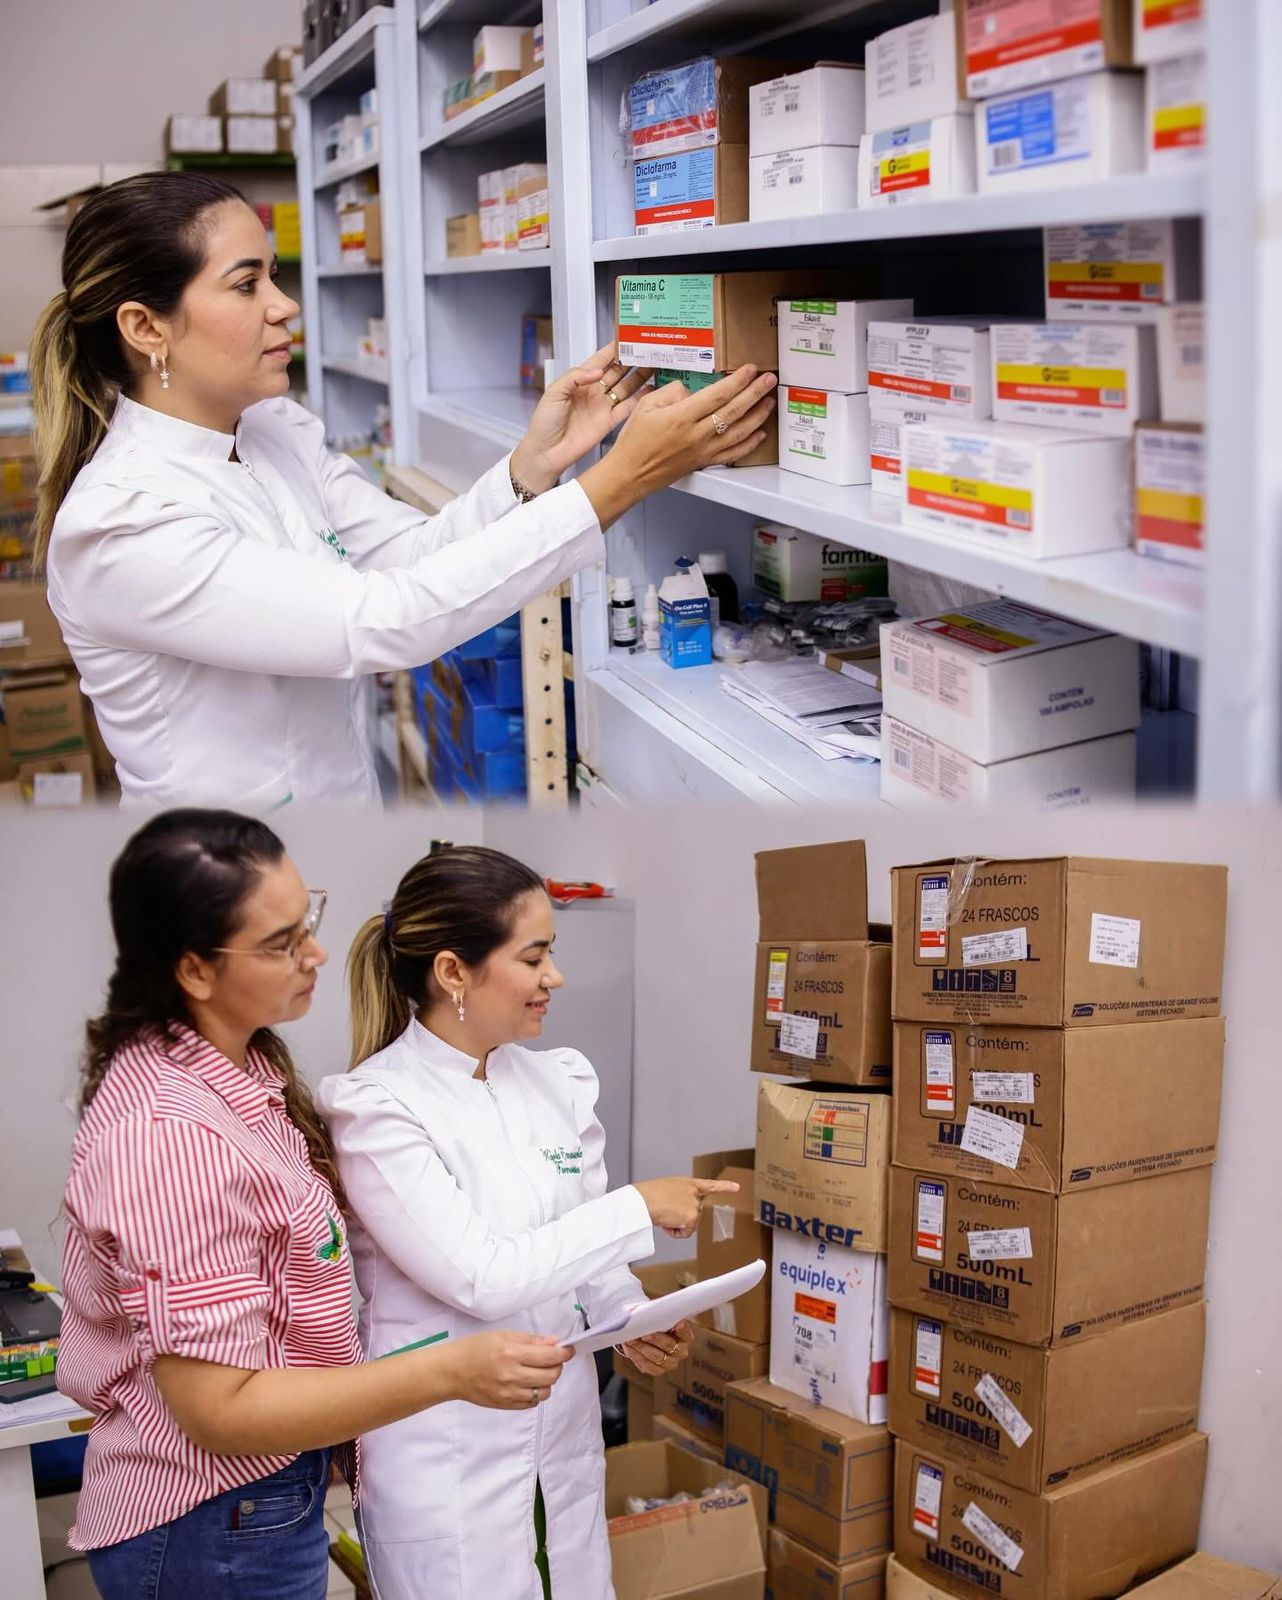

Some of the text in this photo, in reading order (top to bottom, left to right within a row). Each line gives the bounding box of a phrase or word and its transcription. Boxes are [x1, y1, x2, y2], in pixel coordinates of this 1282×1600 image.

[636, 161, 677, 177] Diclofarma
[622, 280, 665, 291] Vitamina C
[821, 544, 888, 564] farma
[962, 906, 1040, 923] 24 FRASCOS
[796, 951, 838, 963] Contém:
[793, 979, 845, 994] 24 FRASCOS
[1098, 1002, 1130, 1011] SOLUÇÕES
[1131, 1000, 1168, 1010] PARENTERAIS
[1176, 998, 1199, 1006] GRANDE
[1136, 1009, 1159, 1017] SISTEMA
[794, 1010, 843, 1028] 0mL
[965, 1034, 1030, 1052] Contém:
[970, 1102, 1043, 1128] 00mL
[1096, 1145, 1216, 1174] SOLUÇÕES PARENTERAIS DE GRANDE VOLUME
[1133, 1159, 1183, 1174] SISTEMA FECHADO
[957, 1187, 1021, 1212] Contém:
[760, 1199, 863, 1249] Baxter
[957, 1219, 971, 1234] 24
[780, 1261, 847, 1295] equiplex
[956, 1252, 1034, 1287] 500mL
[796, 1325, 813, 1341] 708
[953, 1330, 1013, 1359] Contém:
[952, 1361, 967, 1376] 24
[691, 1381, 725, 1405] 500m
[952, 1391, 1000, 1424] 500
[953, 1475, 1013, 1509] Contém:
[951, 1534, 1024, 1578] 500m
